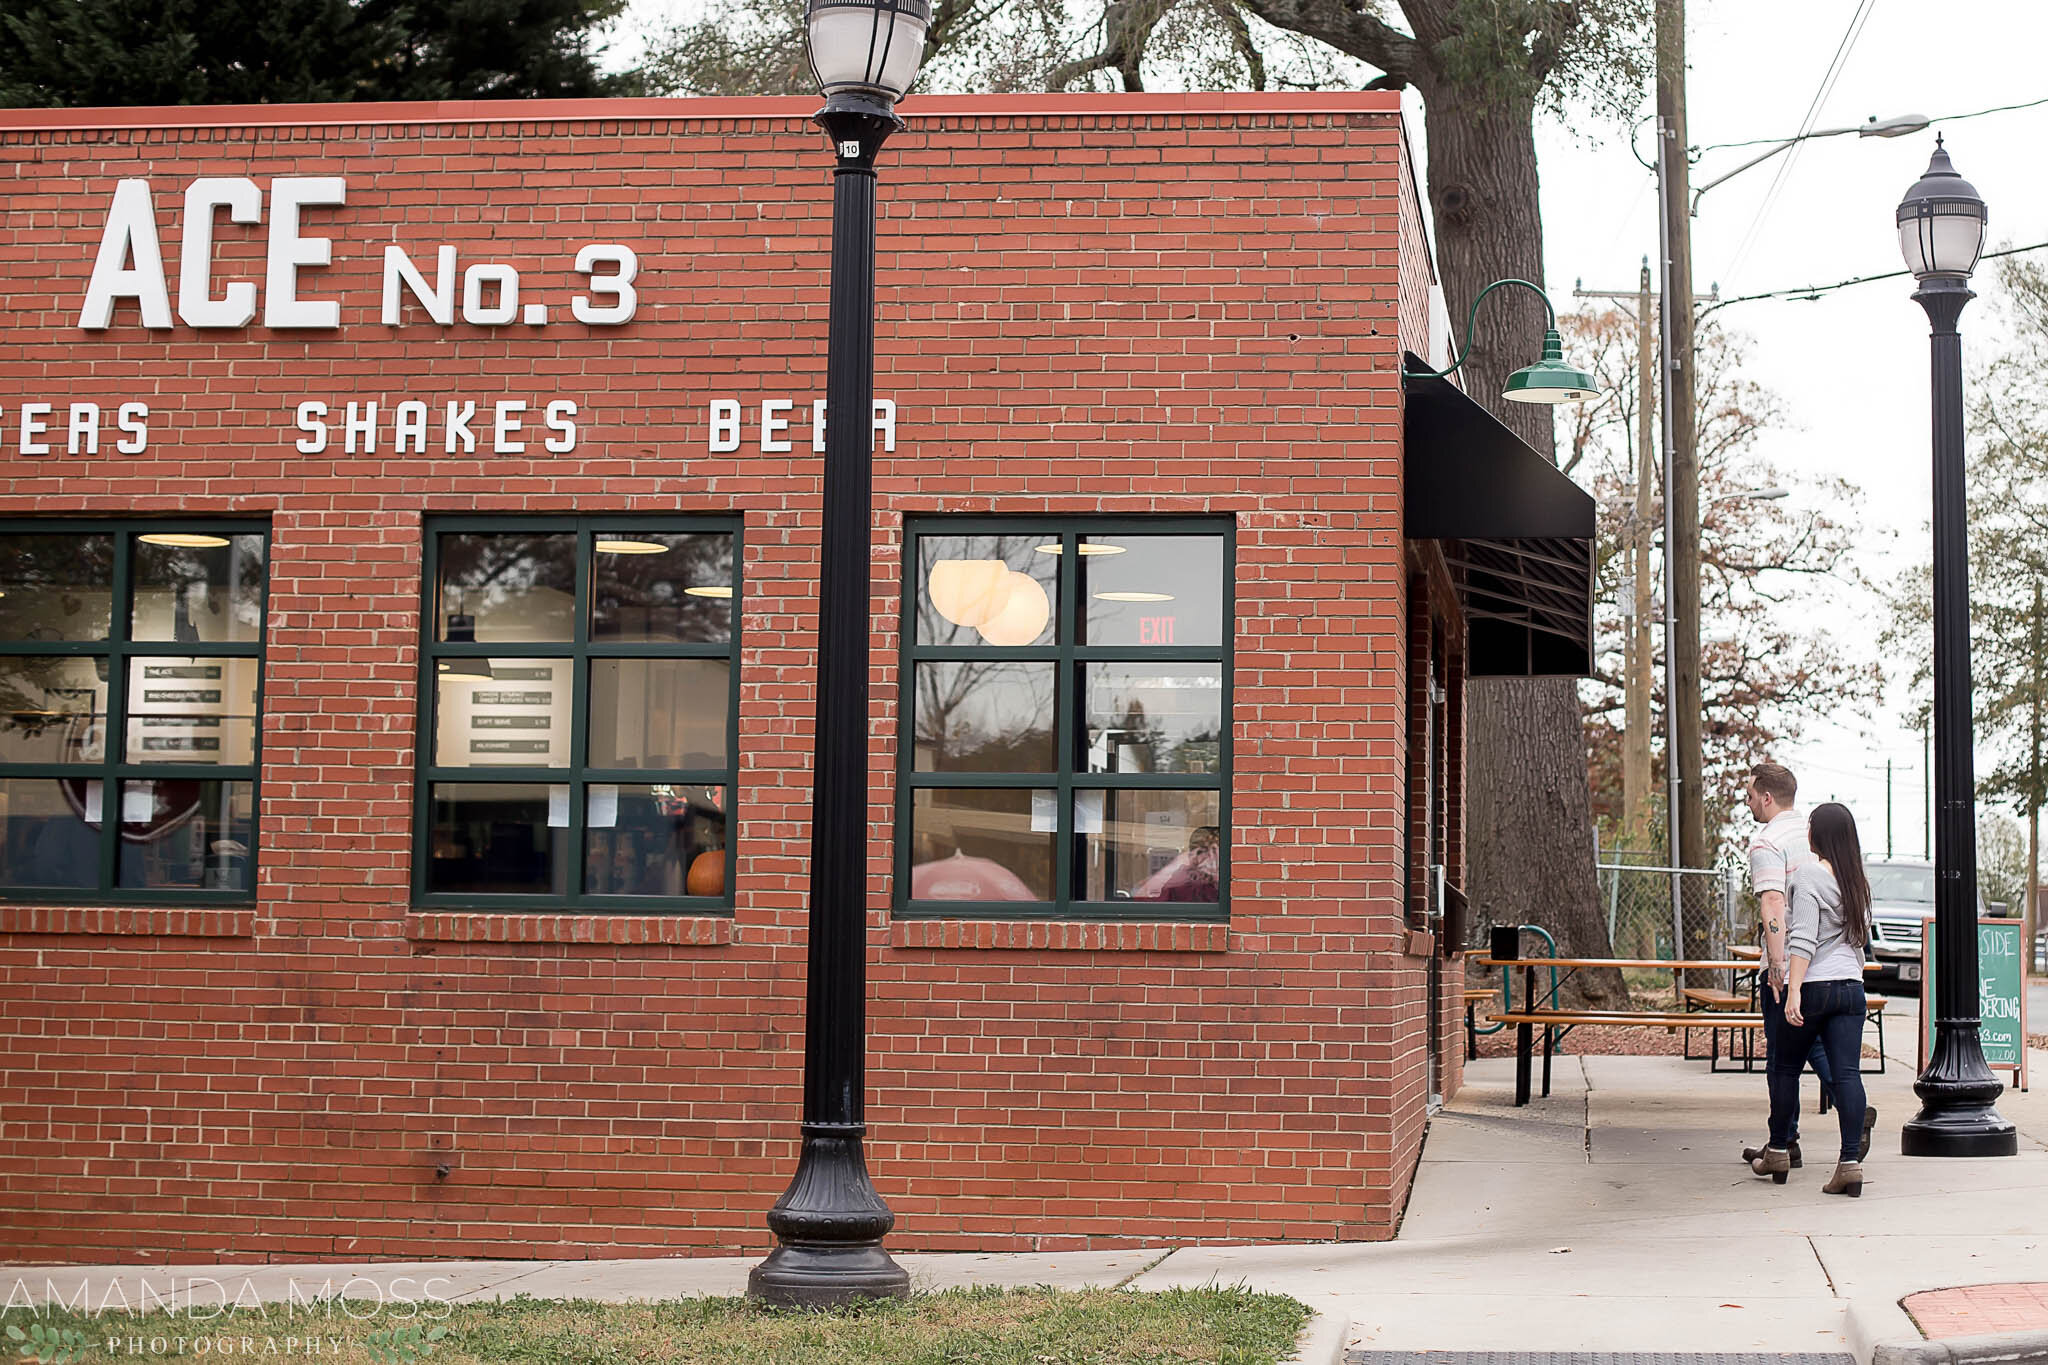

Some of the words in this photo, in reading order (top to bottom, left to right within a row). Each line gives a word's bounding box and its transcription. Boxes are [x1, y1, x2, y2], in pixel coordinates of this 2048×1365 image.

[845, 144, 858, 154] 10
[77, 176, 347, 330] ACE
[380, 244, 548, 326] No.
[570, 243, 639, 326] 3
[0, 401, 149, 455] ERS
[295, 399, 579, 454] SHAKES
[1138, 615, 1177, 645] EXIT
